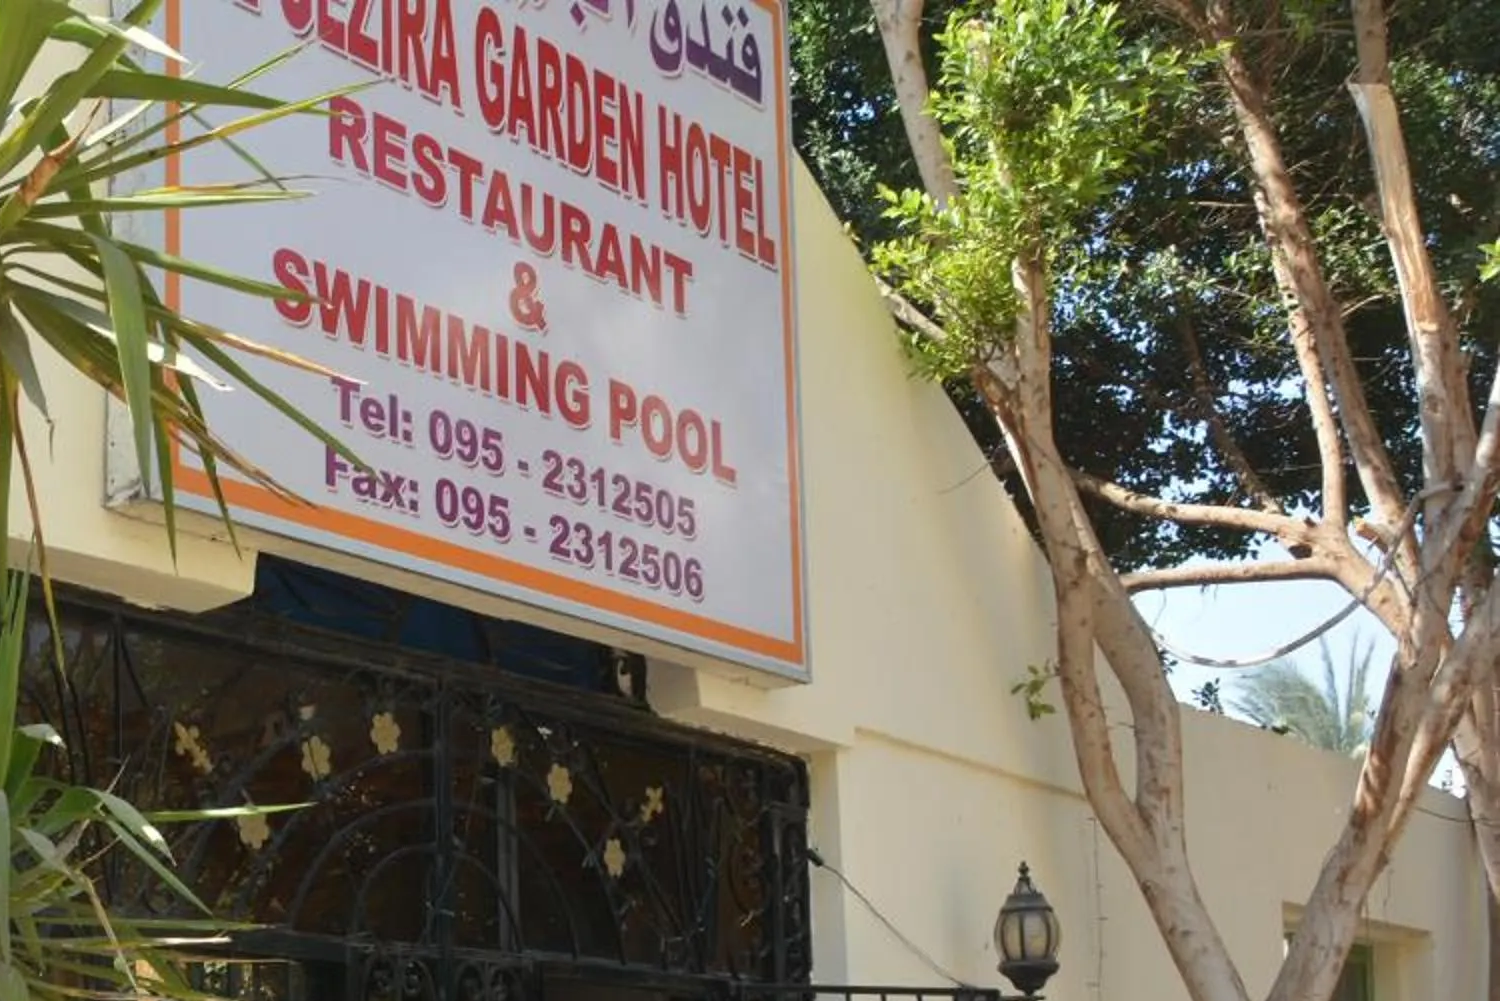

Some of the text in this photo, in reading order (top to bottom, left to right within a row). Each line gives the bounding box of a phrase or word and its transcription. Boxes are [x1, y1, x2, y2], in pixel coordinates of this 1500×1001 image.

[281, 0, 776, 265] ZIRA GARDEN HOTEL
[329, 96, 693, 313] RESTAURANT
[273, 248, 737, 482] SWIMMING POOL
[509, 261, 547, 331] &
[325, 446, 419, 513] Fax:
[436, 478, 511, 539] 095
[549, 514, 704, 600] 2312506
[332, 376, 413, 442] Tel:
[429, 410, 504, 472] 095
[542, 450, 696, 538] 2312505
